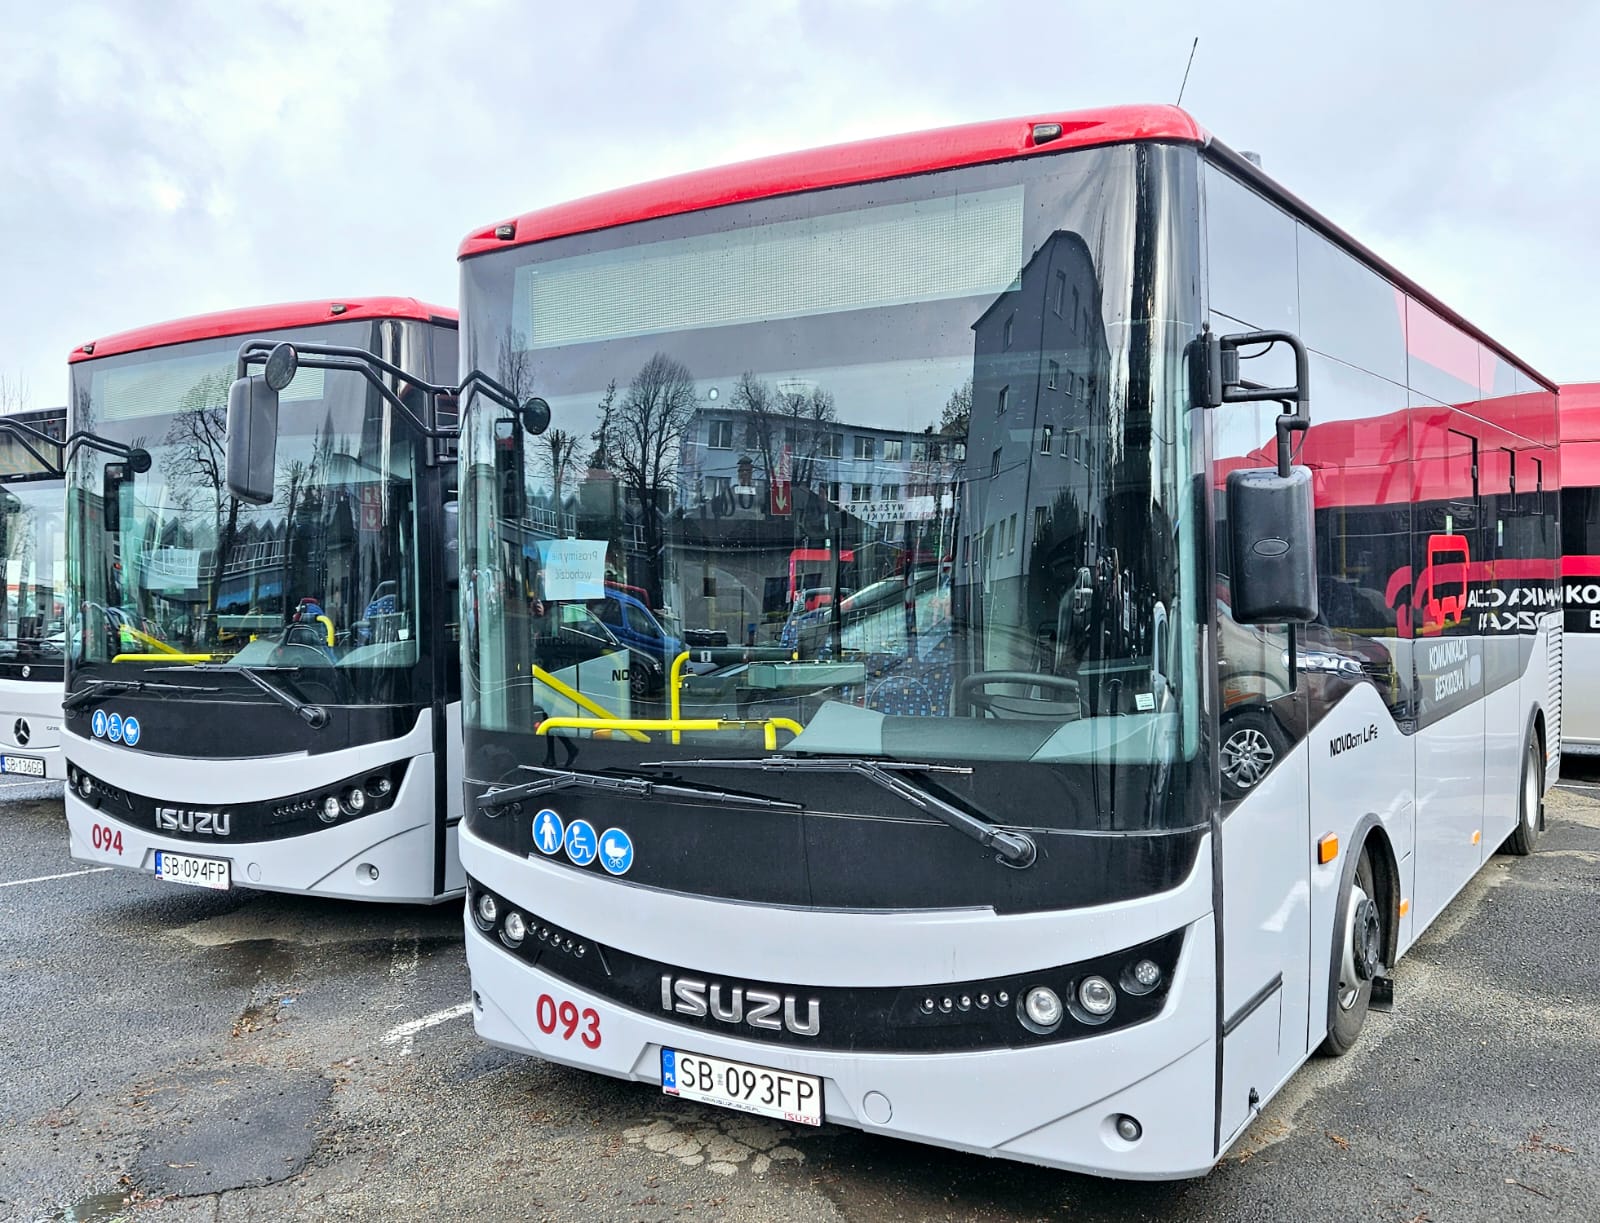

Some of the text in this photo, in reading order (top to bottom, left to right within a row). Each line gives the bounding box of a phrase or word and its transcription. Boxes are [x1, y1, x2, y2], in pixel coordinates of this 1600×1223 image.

[6, 757, 16, 771] SB
[155, 807, 231, 836] ISUZU
[92, 823, 124, 857] 094
[163, 856, 226, 882] SB 094FP
[536, 993, 602, 1050] 093
[661, 976, 820, 1036] ISUZU
[680, 1057, 814, 1111] SB 093FP
[784, 1111, 820, 1127] ISUZU
